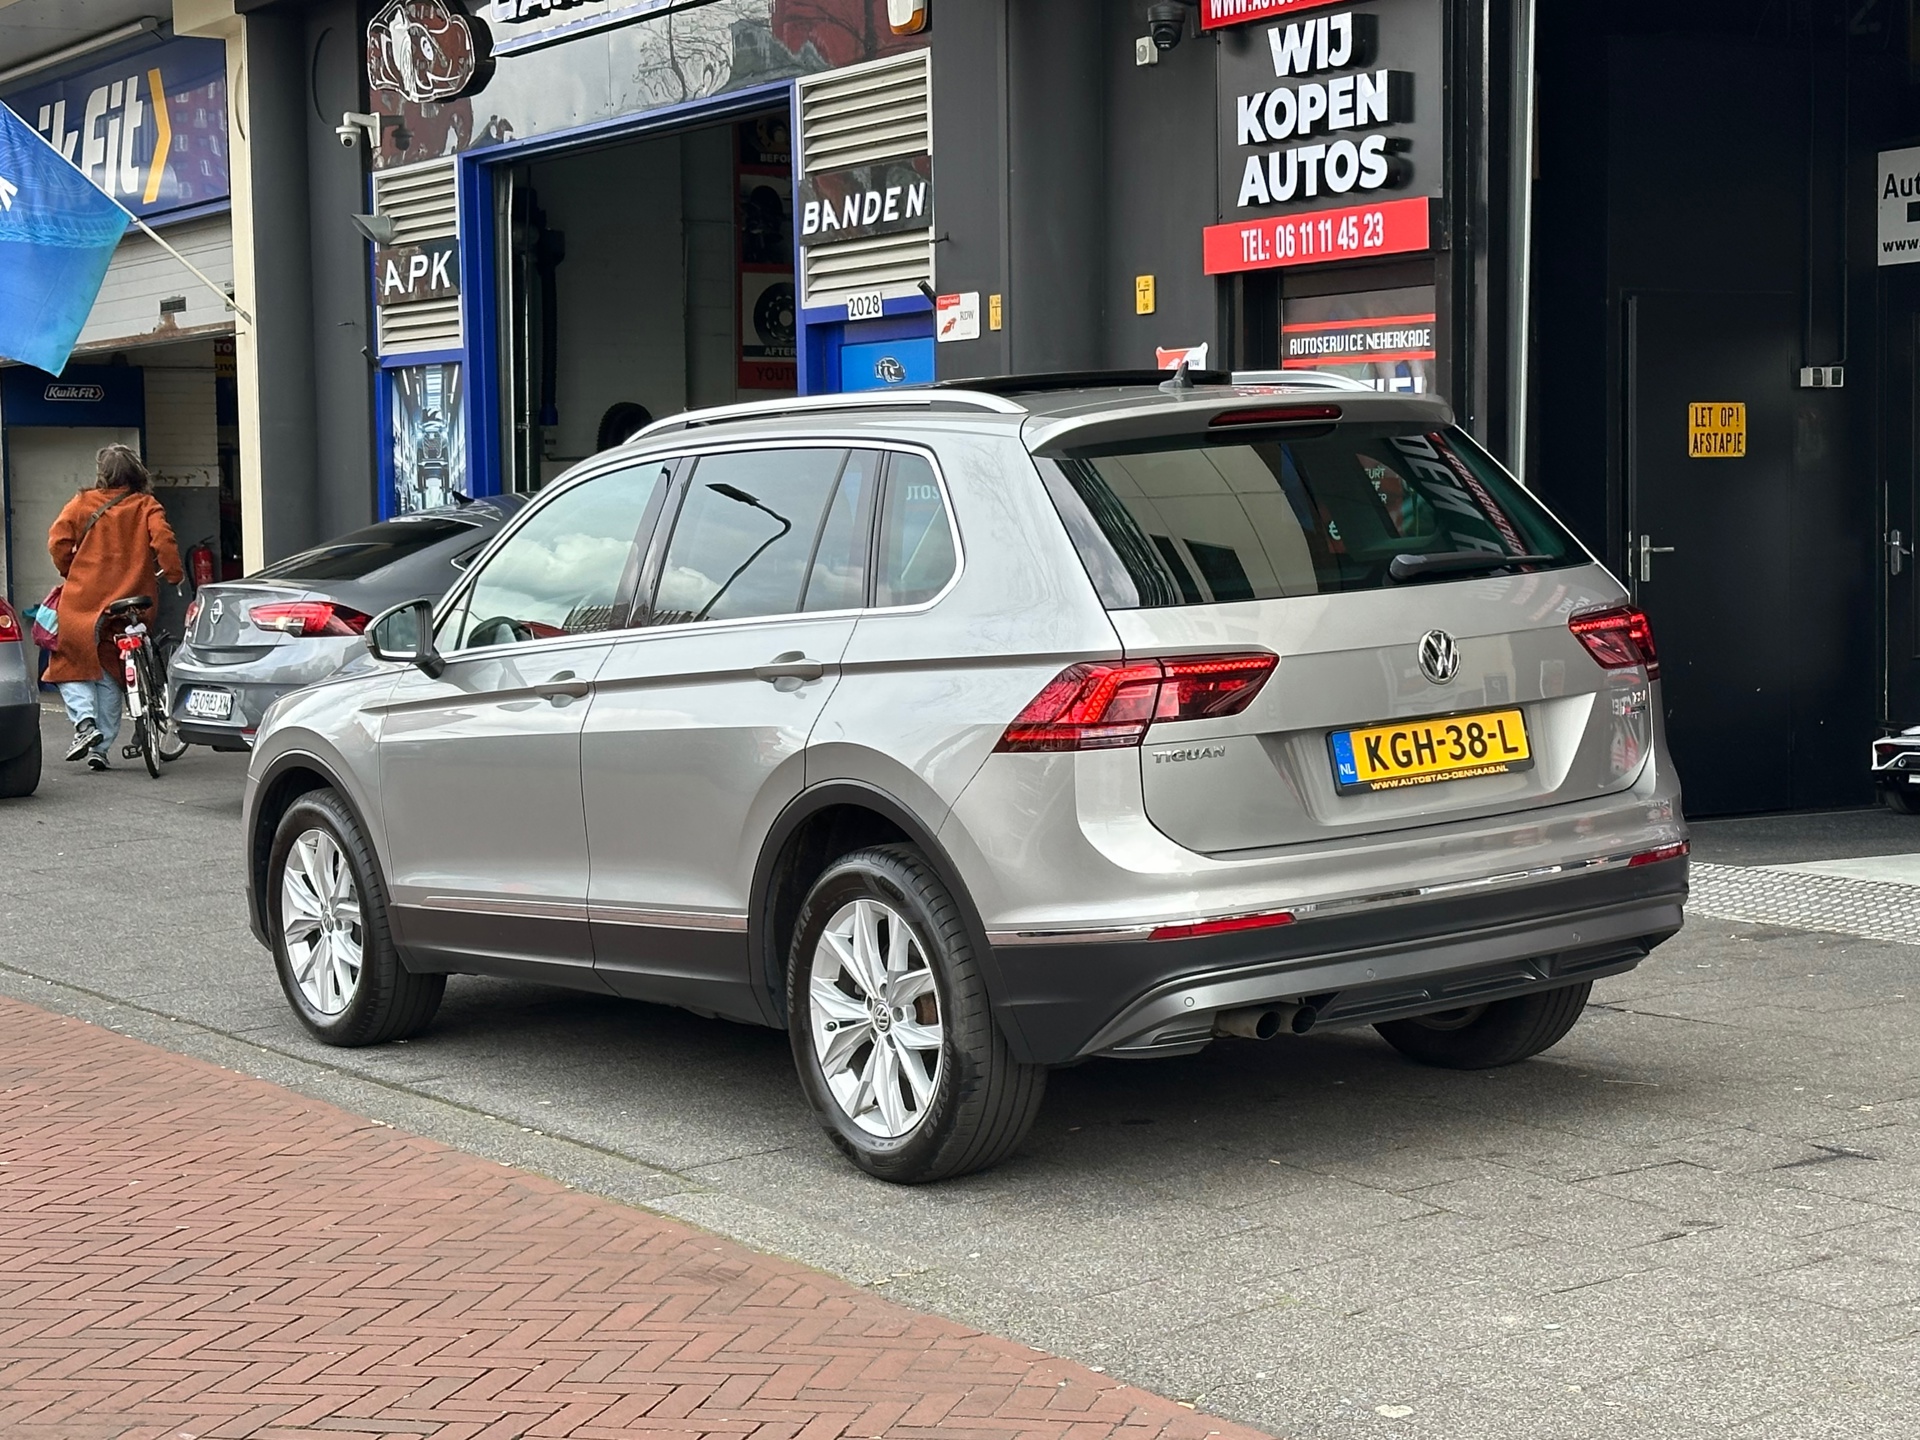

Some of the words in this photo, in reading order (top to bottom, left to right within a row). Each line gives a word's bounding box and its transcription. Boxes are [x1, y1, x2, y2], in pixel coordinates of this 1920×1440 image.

[1267, 12, 1352, 77] WIJ
[1237, 69, 1388, 146] KOPEN
[1237, 134, 1388, 207] AUTOS
[802, 182, 925, 235] BANDEN
[1241, 228, 1270, 262] TEL:
[1275, 223, 1295, 258] 06
[1299, 221, 1314, 254] 11
[1318, 219, 1333, 252] 11
[1337, 215, 1359, 250] 45
[1364, 212, 1384, 247] 23
[384, 250, 453, 296] APK
[849, 295, 880, 317] 2028
[1290, 333, 1364, 355] AUTOSERVICE
[1366, 329, 1431, 349] NEHERKADE
[1695, 407, 1713, 427] LET
[1721, 407, 1740, 427] OP!
[1693, 432, 1743, 453] AFSTAPJE
[1152, 745, 1226, 763] TIGUAN
[1340, 763, 1355, 775] NL
[1364, 719, 1519, 773] KGH-38-L
